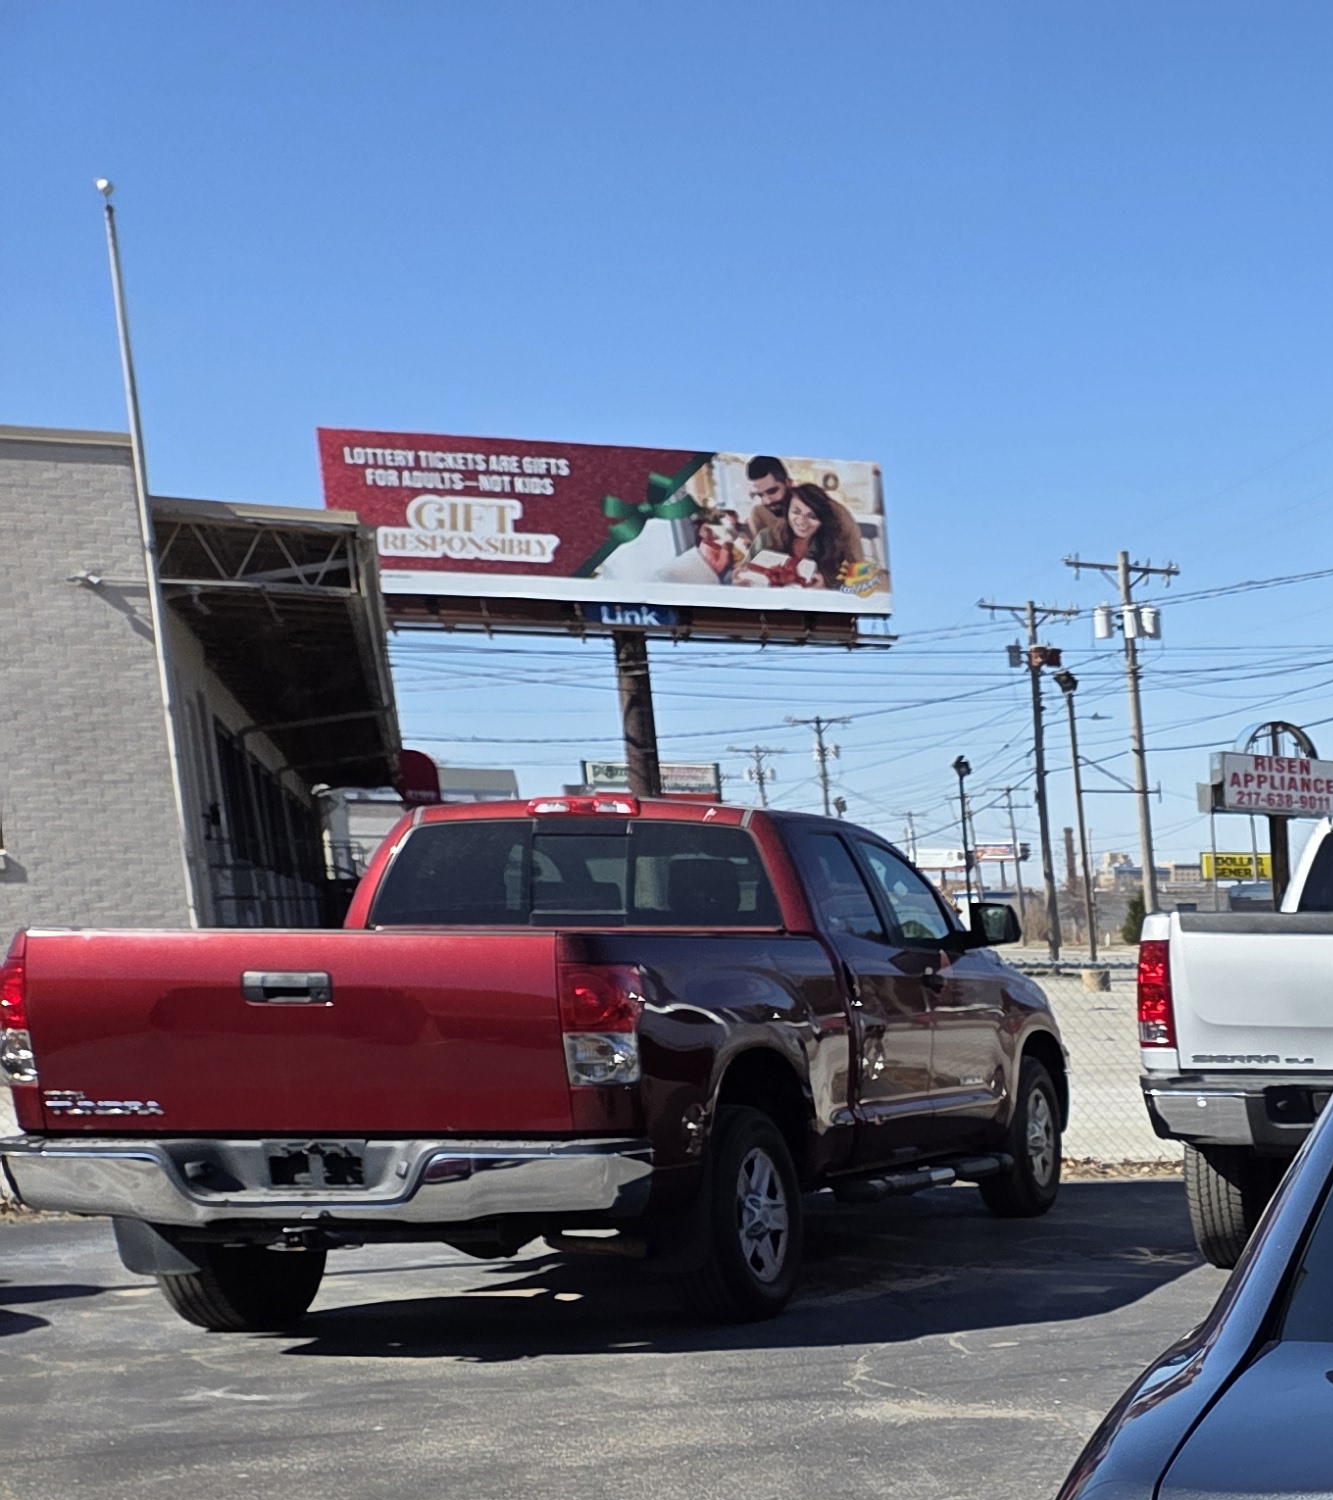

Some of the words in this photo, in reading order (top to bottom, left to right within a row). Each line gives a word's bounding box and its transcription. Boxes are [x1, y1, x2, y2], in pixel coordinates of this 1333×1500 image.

[343, 446, 415, 467] LOTTERY
[417, 450, 487, 471] TICKETS
[489, 455, 522, 473] ARE
[522, 456, 570, 476] GIFTS
[365, 468, 399, 487] FOR
[514, 476, 554, 495] KIDS
[414, 501, 516, 534] GIFT
[383, 532, 551, 557] RESPONSIBLY
[600, 605, 661, 626] Link
[1254, 756, 1311, 775] RISEN
[1215, 867, 1268, 878] GENERL
[1191, 1054, 1280, 1064] SIERRA
